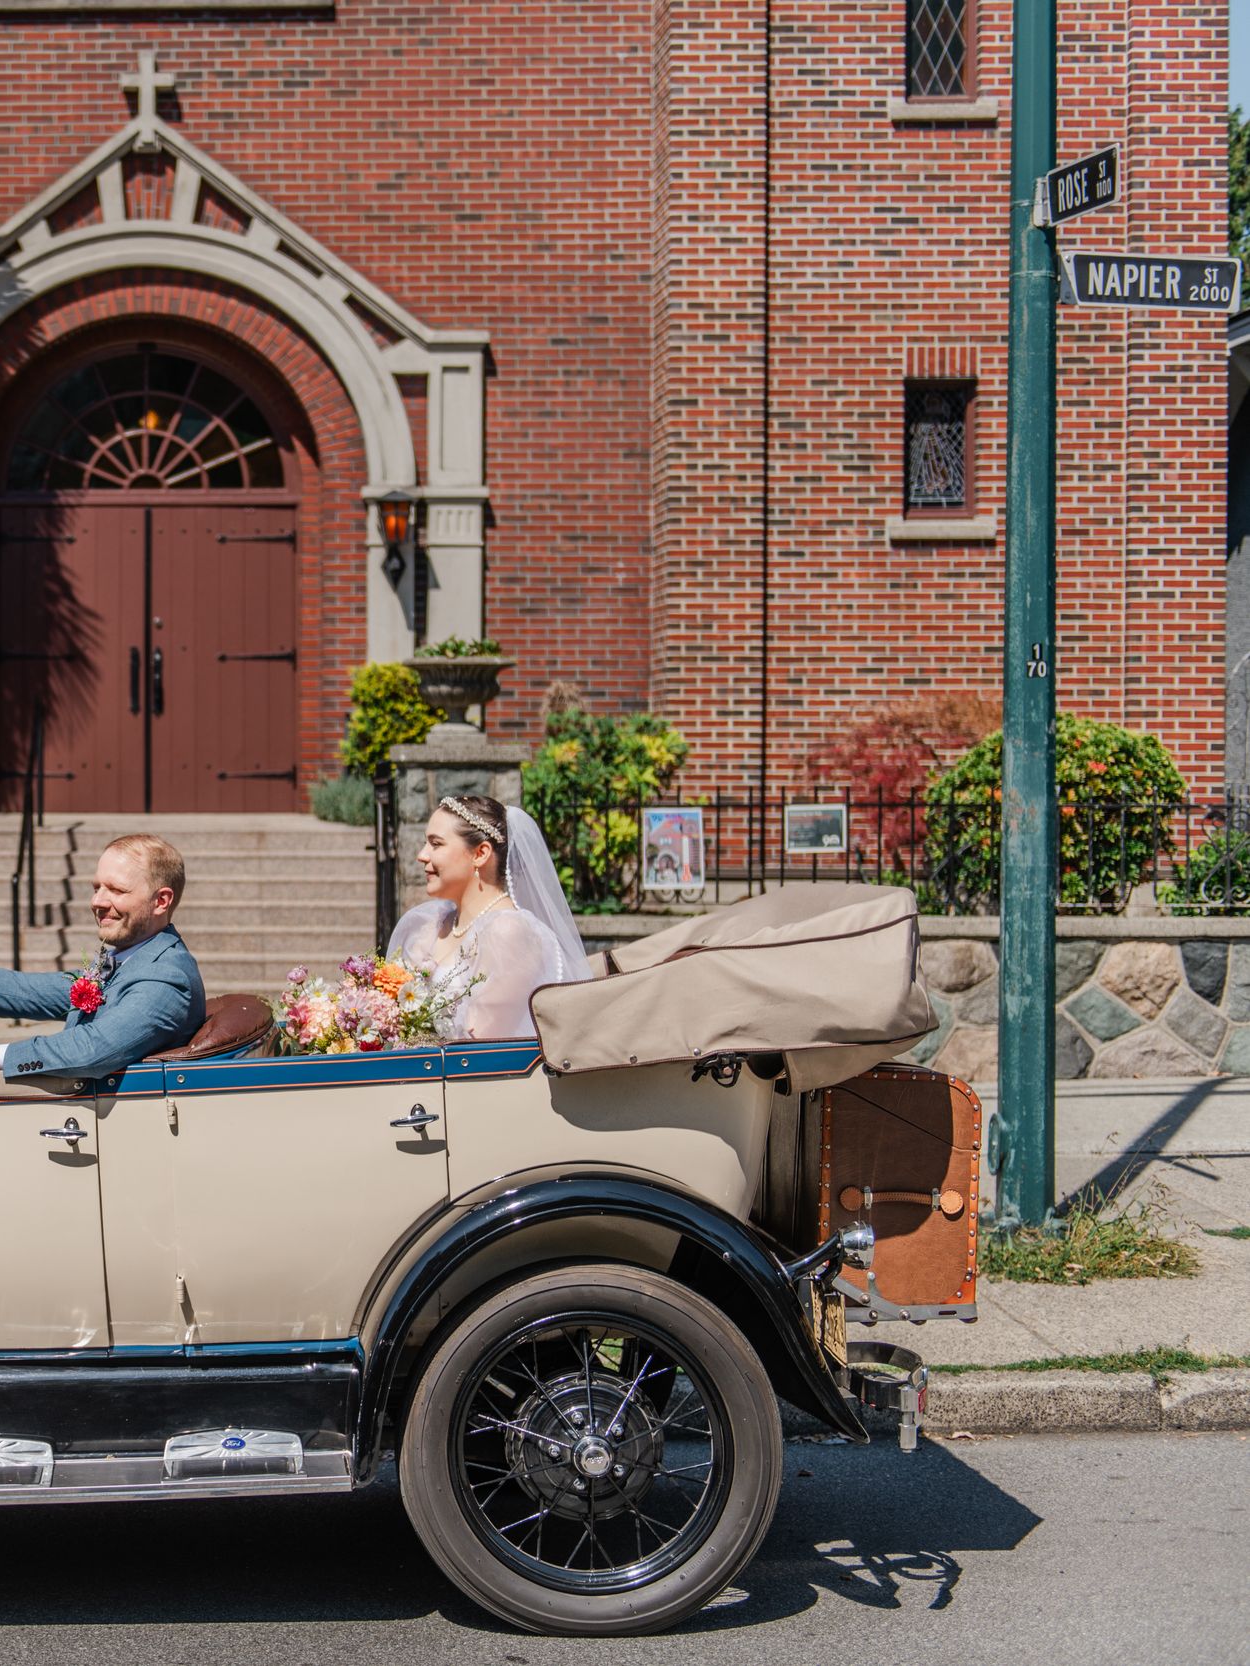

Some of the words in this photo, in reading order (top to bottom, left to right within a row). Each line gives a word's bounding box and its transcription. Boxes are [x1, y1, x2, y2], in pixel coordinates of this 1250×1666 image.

[1057, 167, 1090, 213] ROSE
[1098, 160, 1107, 178] ST
[1095, 176, 1112, 199] 1100
[1088, 262, 1181, 300] NAPIER
[1203, 268, 1219, 284] ST
[1189, 285, 1230, 302] 2000
[1033, 643, 1041, 660] 1
[1027, 661, 1047, 678] 70
[225, 1439, 241, 1447] Ford
